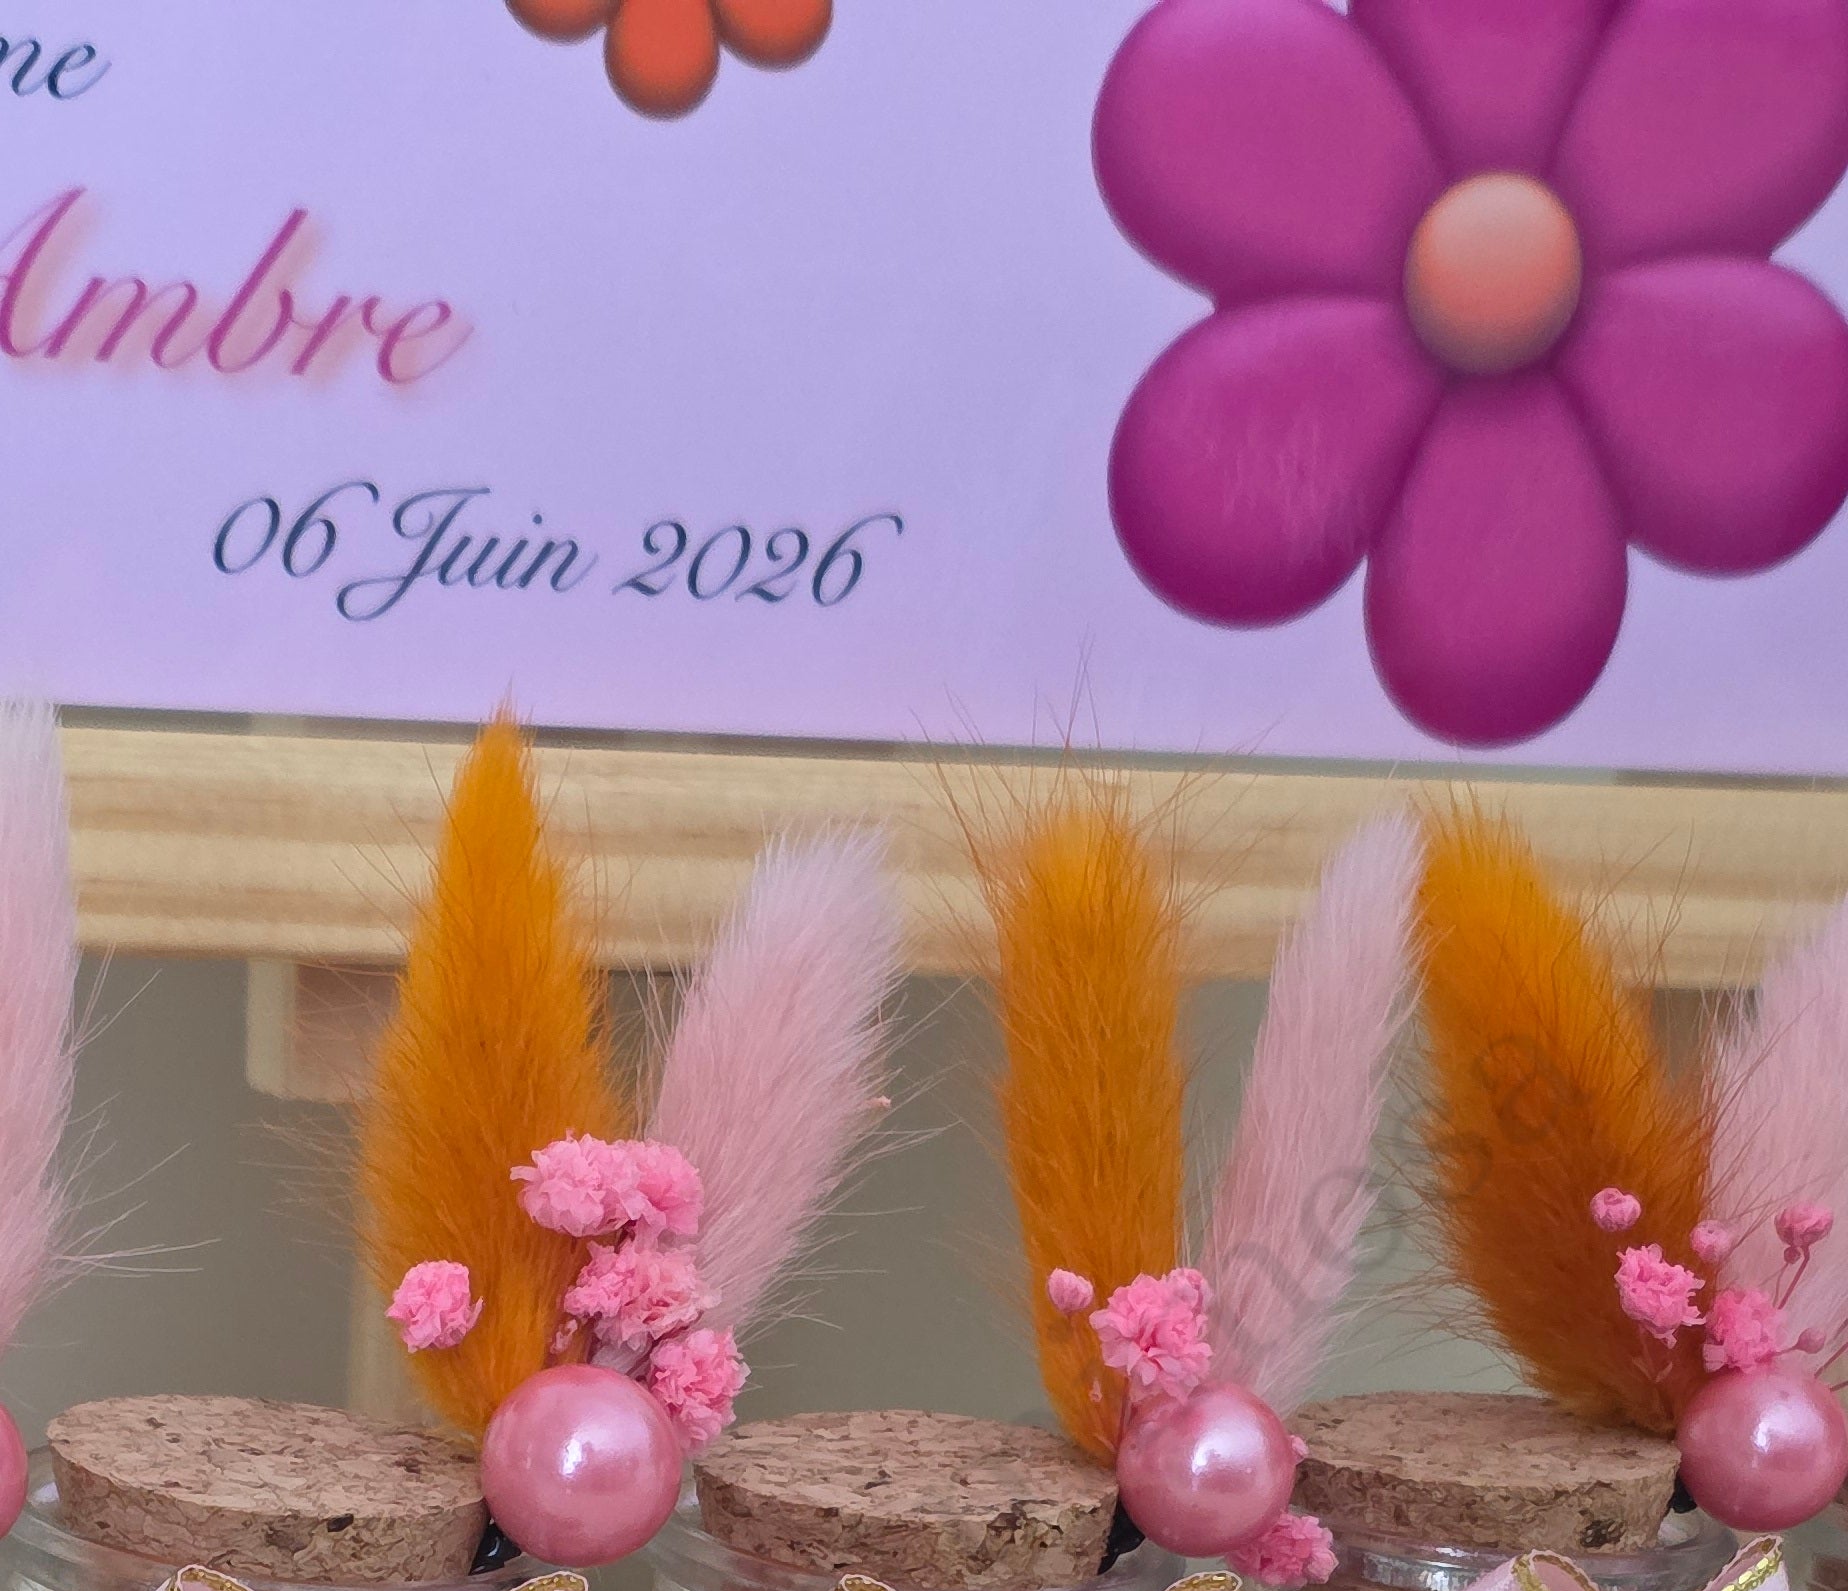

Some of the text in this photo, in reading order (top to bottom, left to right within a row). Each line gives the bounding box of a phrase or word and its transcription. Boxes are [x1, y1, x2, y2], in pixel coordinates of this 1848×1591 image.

[211, 479, 906, 623] 06 Juin 2026
